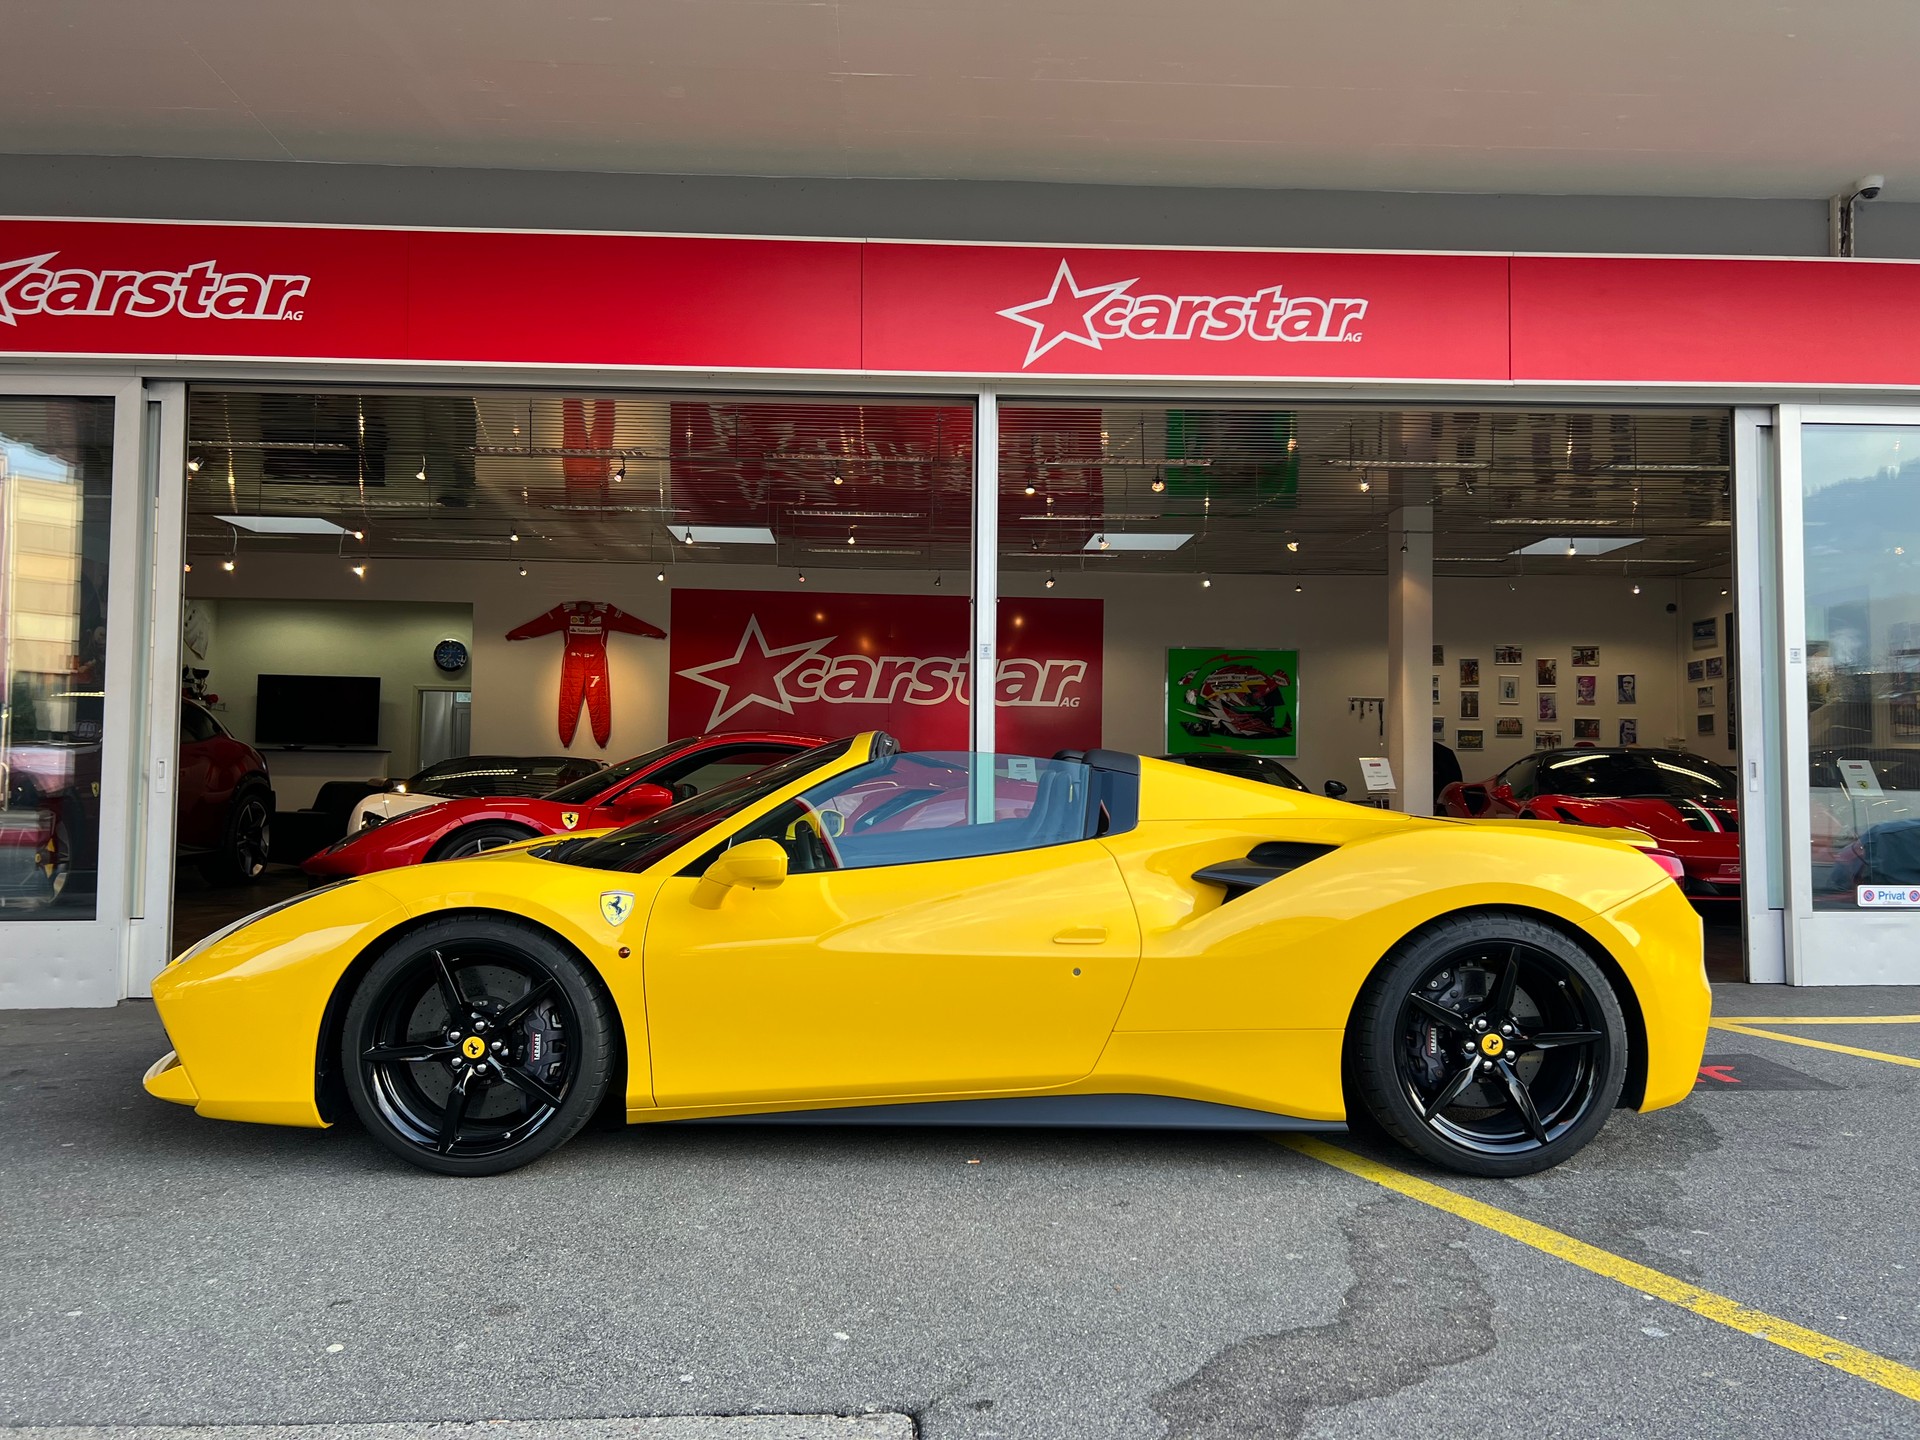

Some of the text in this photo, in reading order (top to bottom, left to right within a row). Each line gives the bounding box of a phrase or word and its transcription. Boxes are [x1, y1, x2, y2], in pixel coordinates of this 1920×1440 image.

[4, 260, 311, 321] carstar AG
[1088, 285, 1368, 342] carstar AG
[590, 675, 600, 687] 7
[1060, 697, 1080, 708] AG
[1878, 891, 1905, 900] Privat
